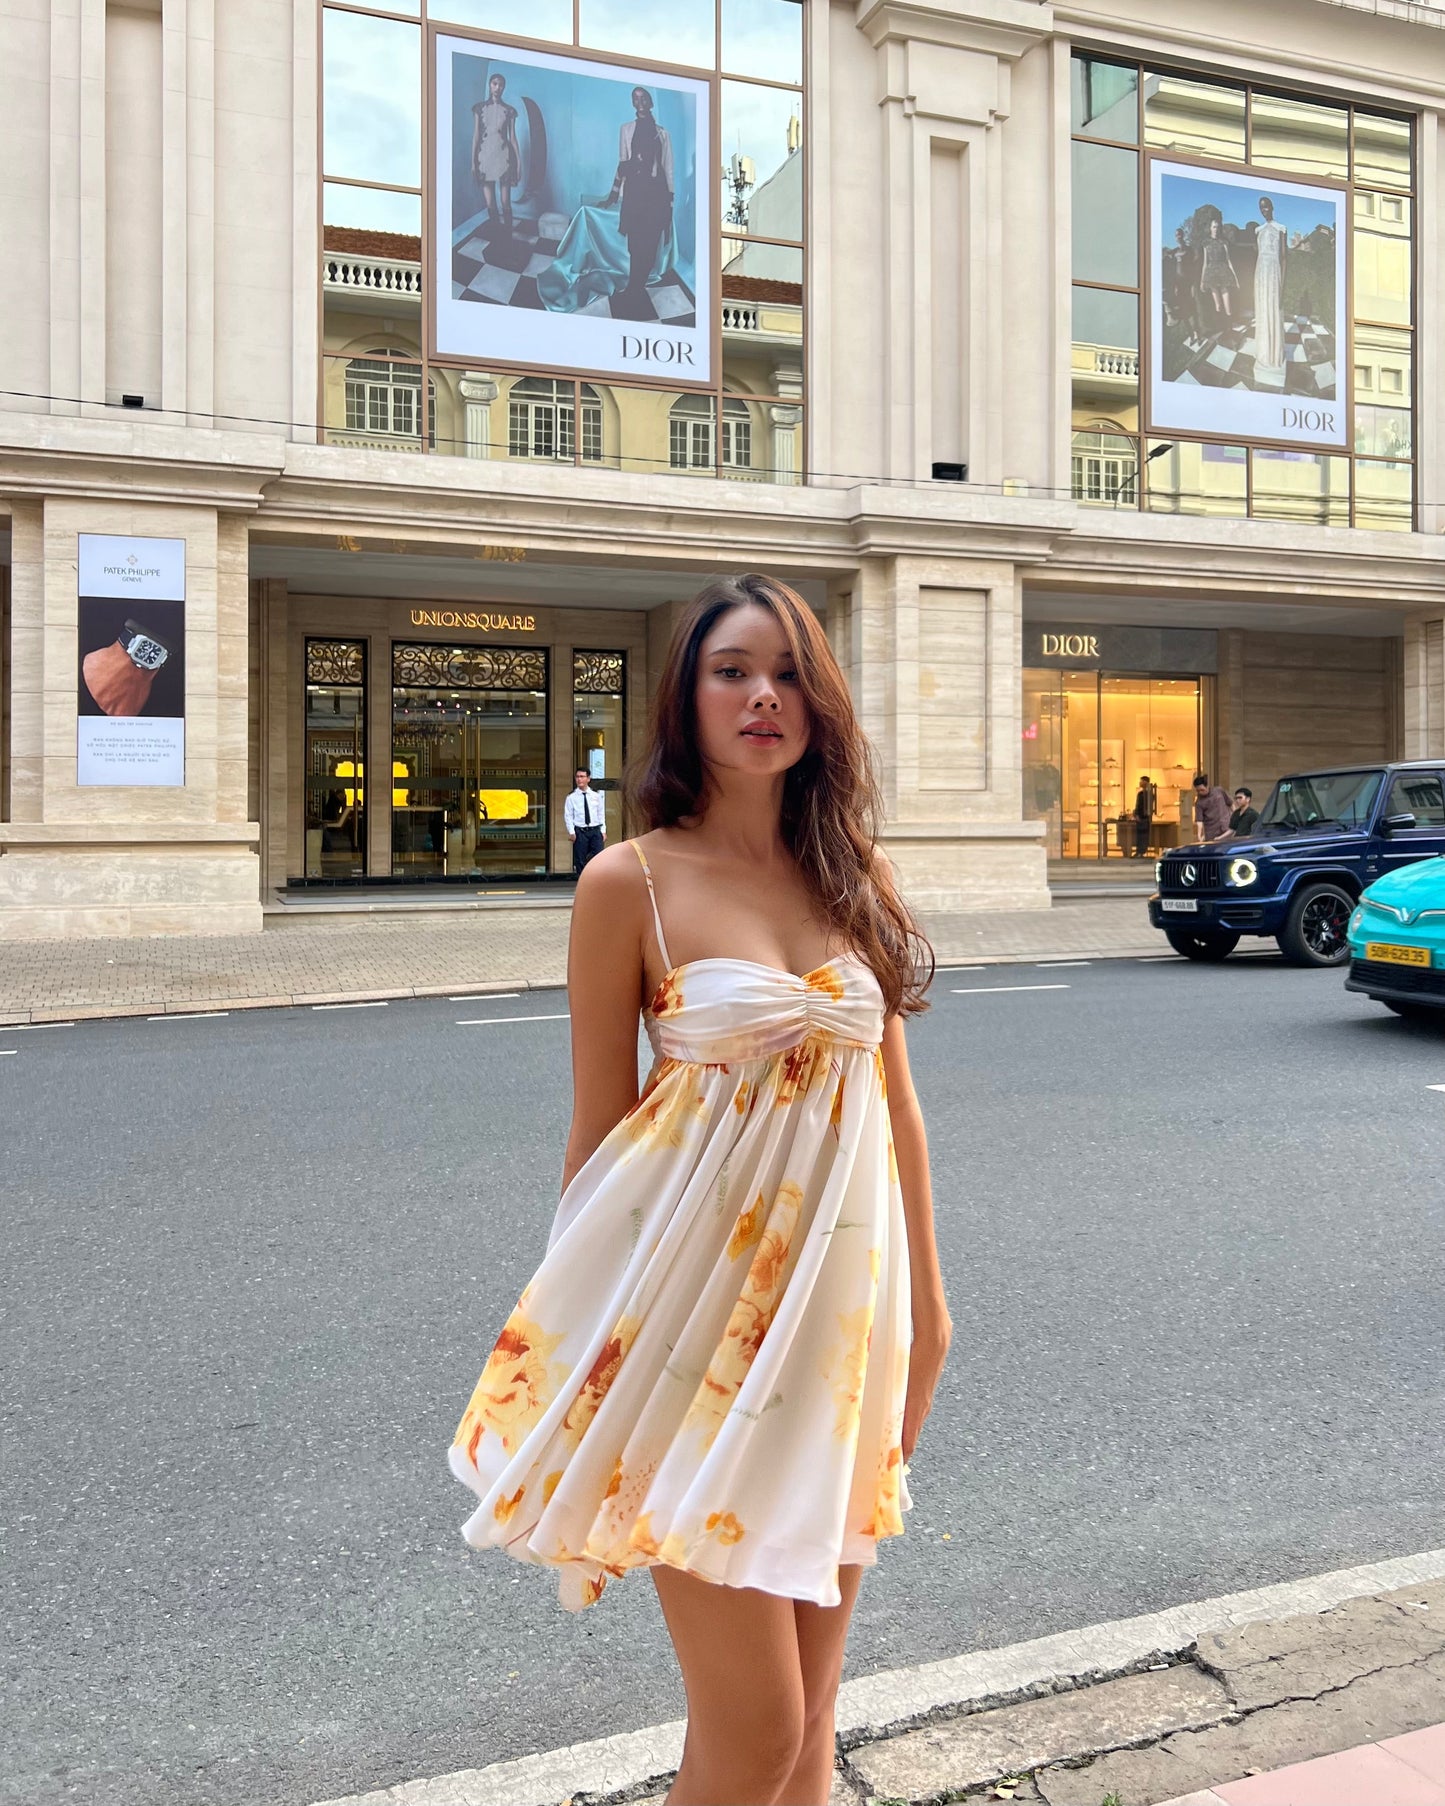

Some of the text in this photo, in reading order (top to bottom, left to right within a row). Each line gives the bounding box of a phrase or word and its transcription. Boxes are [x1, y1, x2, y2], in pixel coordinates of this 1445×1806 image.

[621, 335, 696, 366] DIOR
[1281, 408, 1336, 433] DIOR
[103, 566, 161, 577] PATEK PHILIPPE
[411, 610, 536, 632] UNIONSQUARE
[1042, 634, 1100, 657] DIOR
